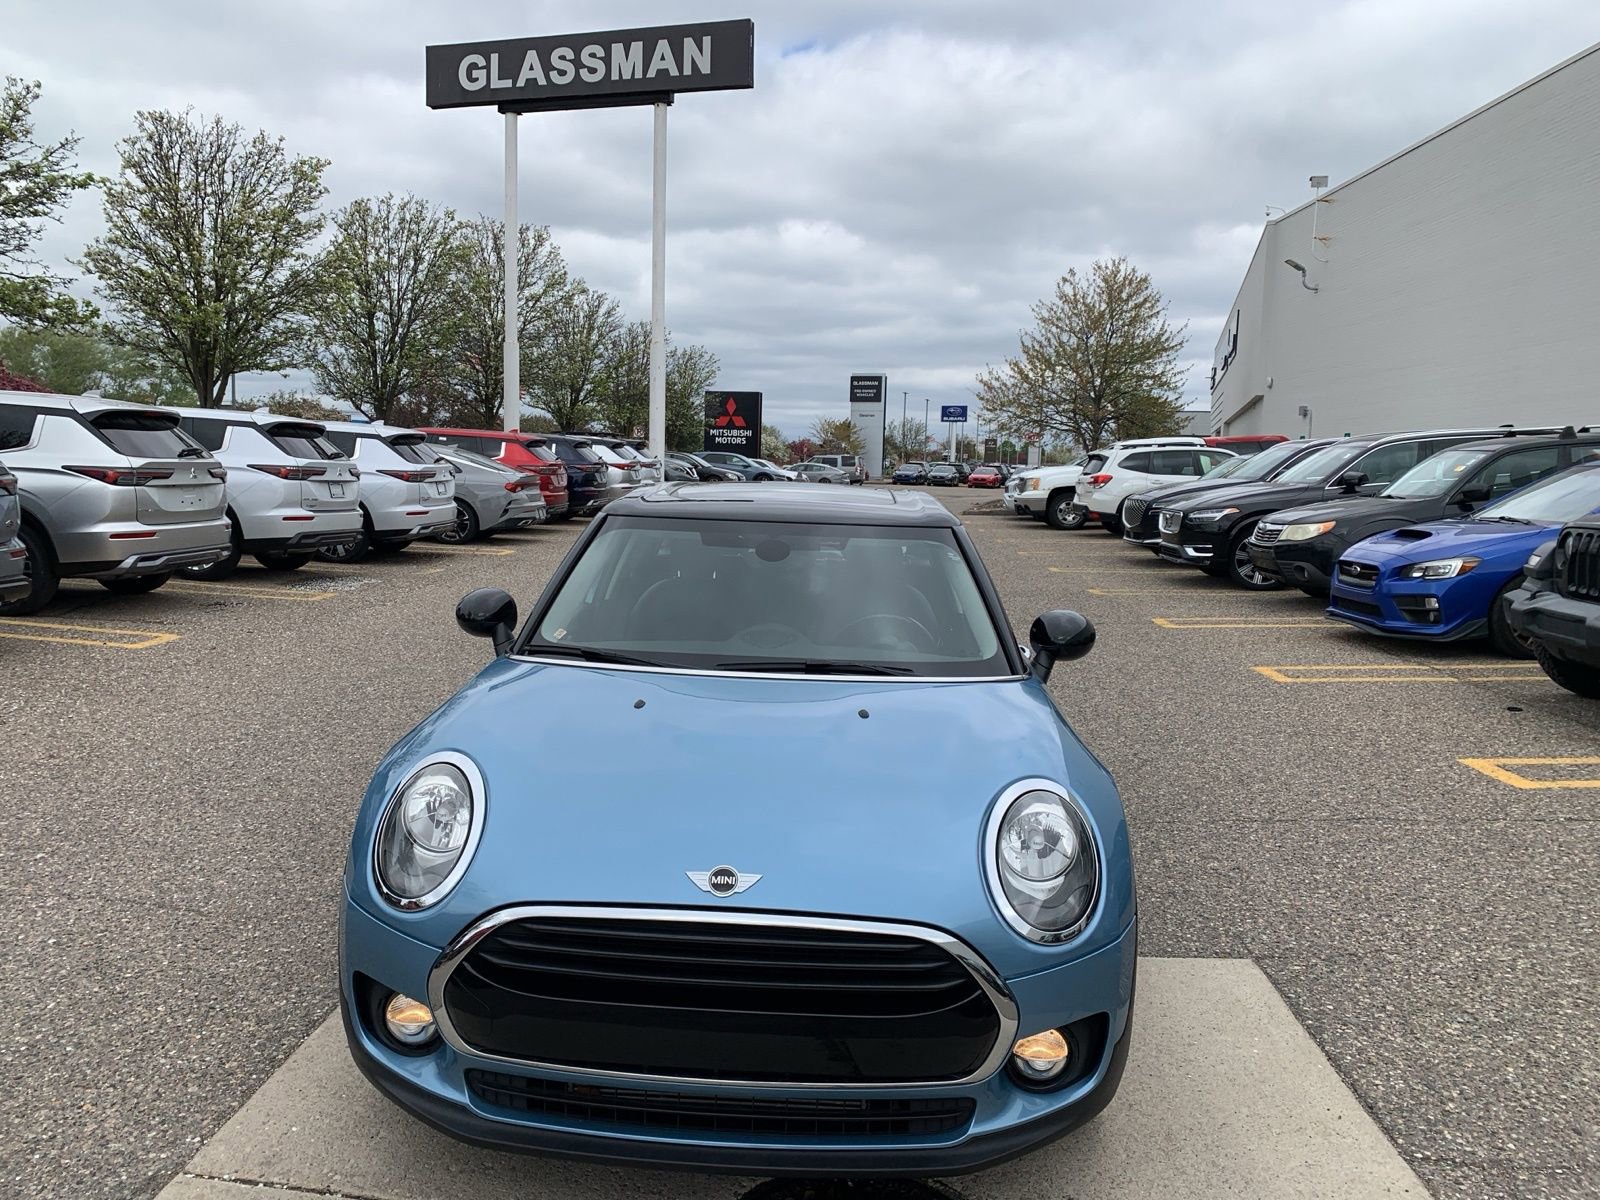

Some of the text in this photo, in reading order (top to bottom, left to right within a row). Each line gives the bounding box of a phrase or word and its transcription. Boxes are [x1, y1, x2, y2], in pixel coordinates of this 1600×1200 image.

[458, 35, 712, 92] GLASSMAN
[709, 429, 753, 437] MITSUBISHI
[715, 437, 747, 445] MOTORS
[711, 875, 736, 885] MINI
